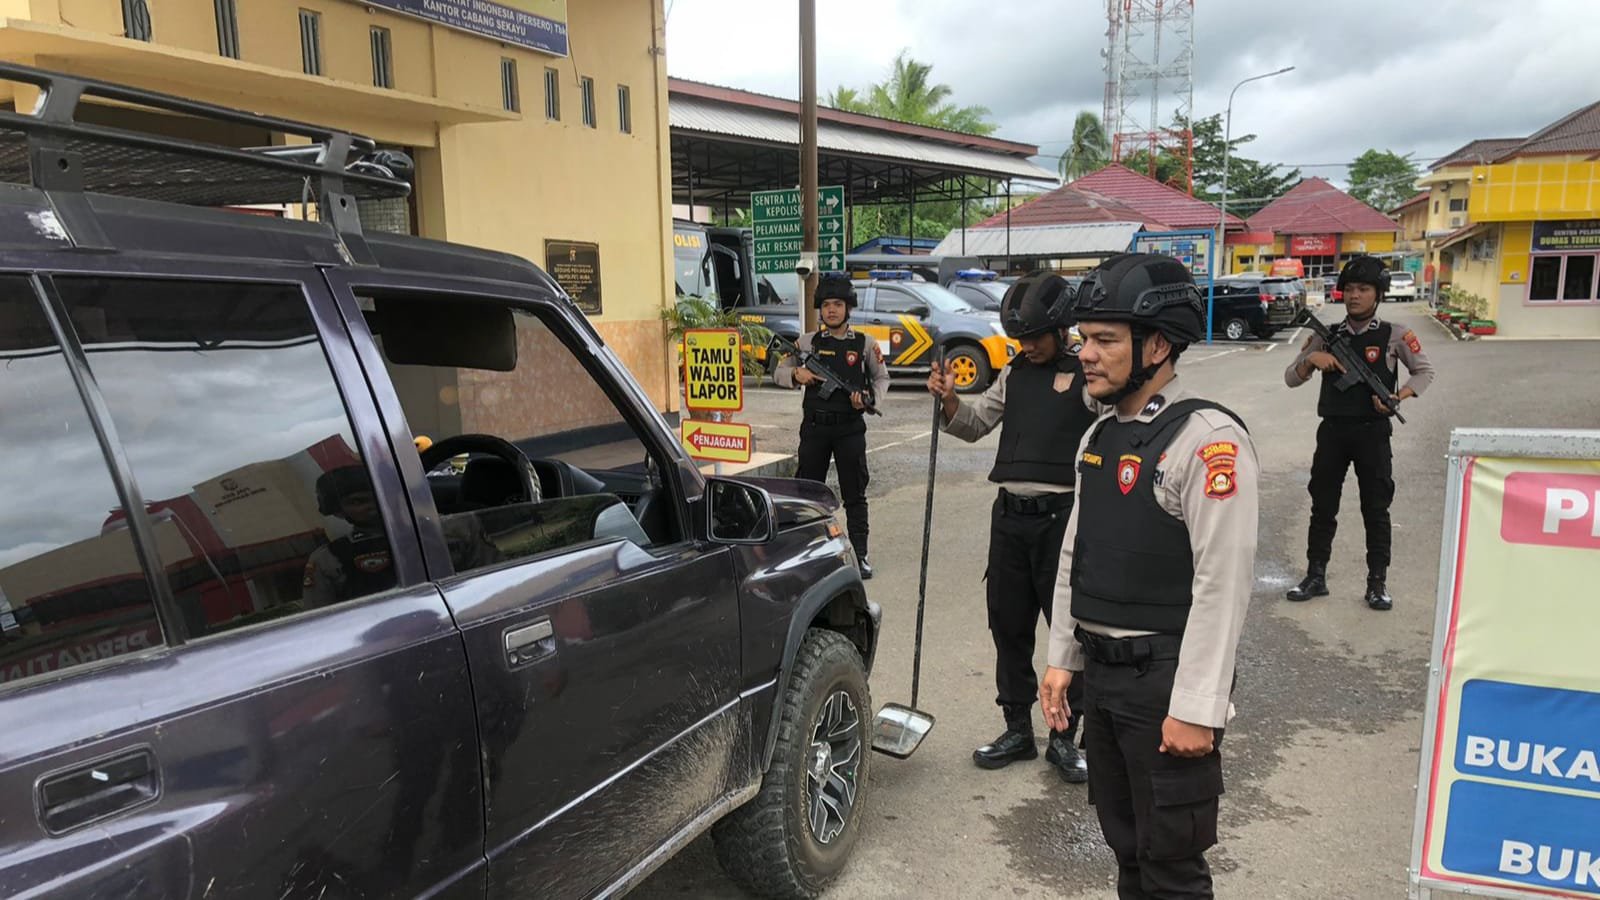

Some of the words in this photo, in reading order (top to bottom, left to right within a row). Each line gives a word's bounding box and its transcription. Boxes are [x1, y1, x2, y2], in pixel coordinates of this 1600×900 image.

[424, 0, 459, 18] KANTOR
[461, 9, 495, 27] CABANG
[497, 19, 527, 36] SEKAYU
[472, 0, 515, 20] INDONESIA
[516, 13, 553, 34] (PERSERO)
[554, 24, 567, 35] Tbk
[754, 194, 784, 206] SENTRA
[755, 223, 800, 235] PELAYANAN
[674, 232, 701, 249] OLISI
[756, 242, 770, 253] SAT
[774, 241, 801, 252] RESKRI
[1540, 236, 1569, 245] DUMAS
[757, 260, 771, 270] SAT
[692, 348, 733, 365] TAMU
[690, 366, 736, 383] WAJIB
[690, 384, 738, 401] LAPOR
[693, 434, 744, 449] PENJAGAAN
[1464, 735, 1600, 782] BUKA
